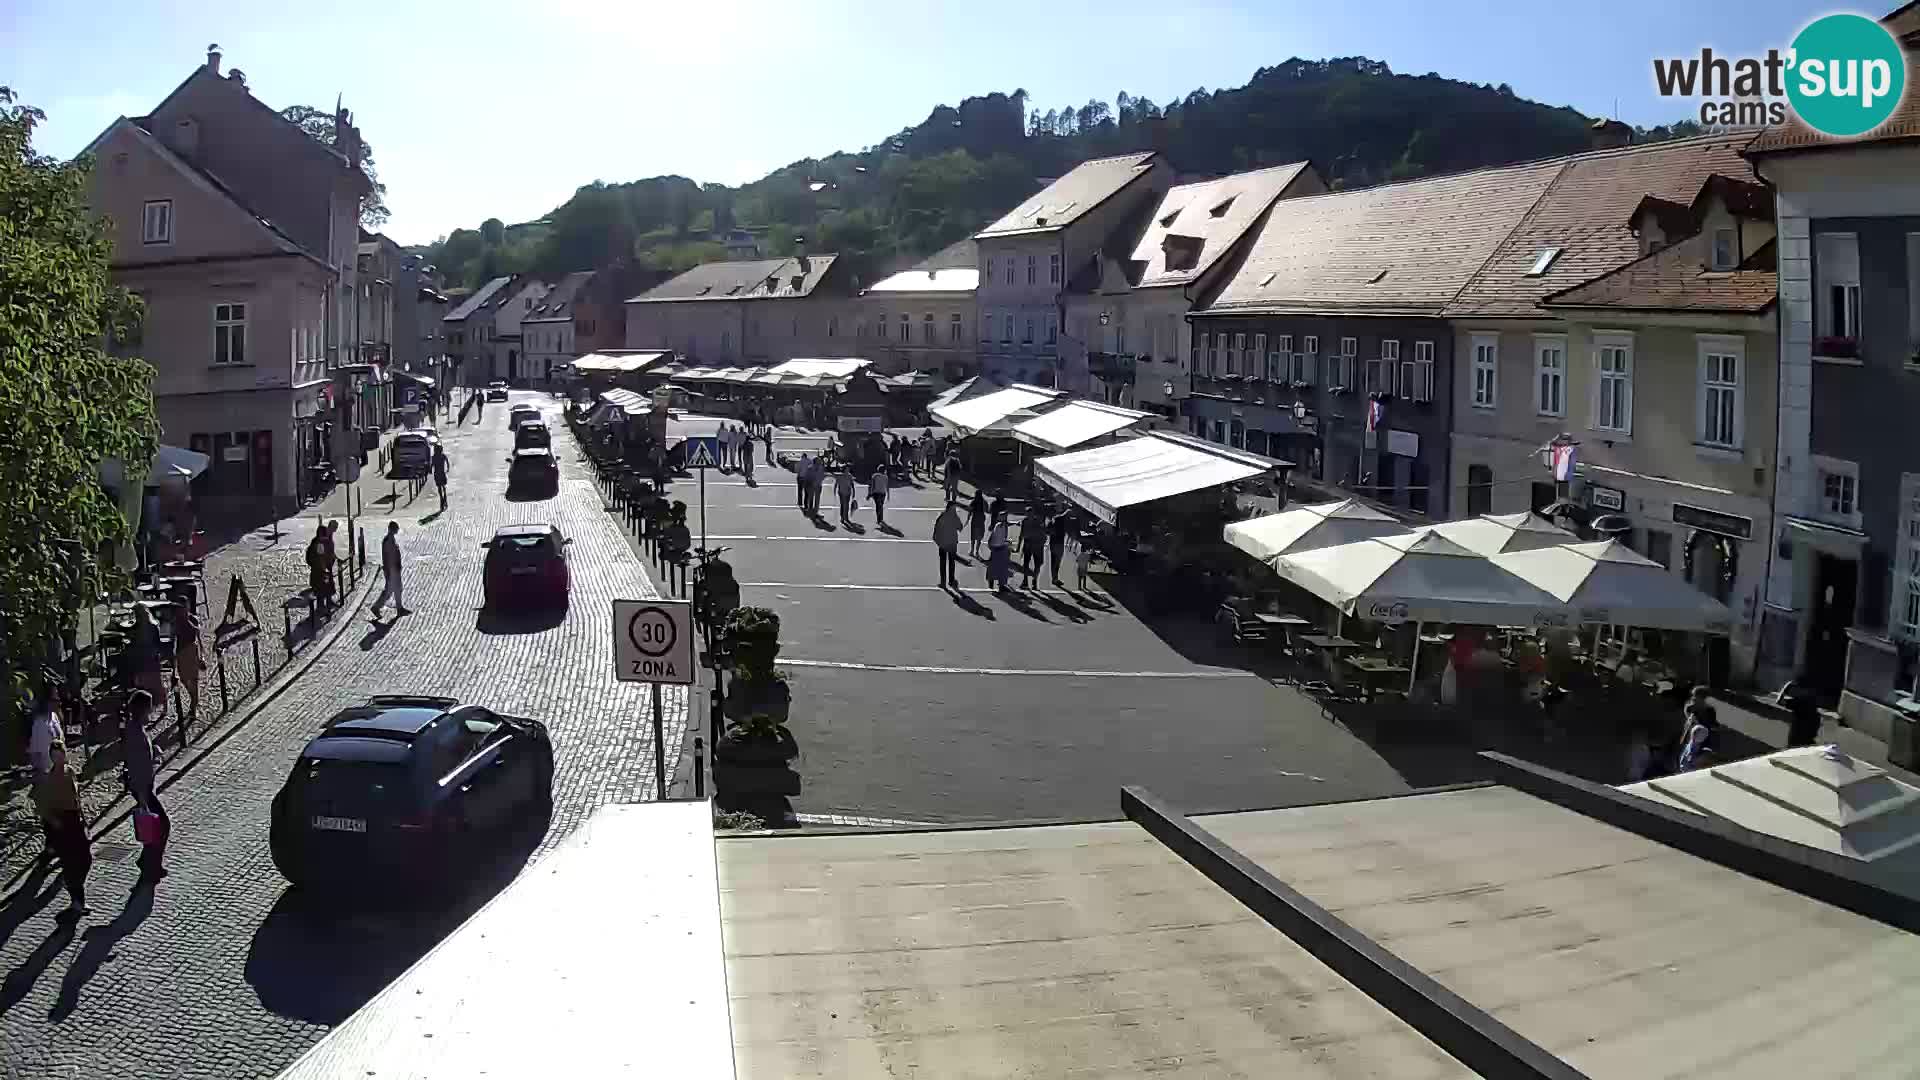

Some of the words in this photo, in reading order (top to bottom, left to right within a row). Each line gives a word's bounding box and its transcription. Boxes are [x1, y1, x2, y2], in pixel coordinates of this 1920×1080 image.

[407, 390, 415, 402] P
[641, 622, 665, 643] 30
[631, 660, 676, 677] ZONA
